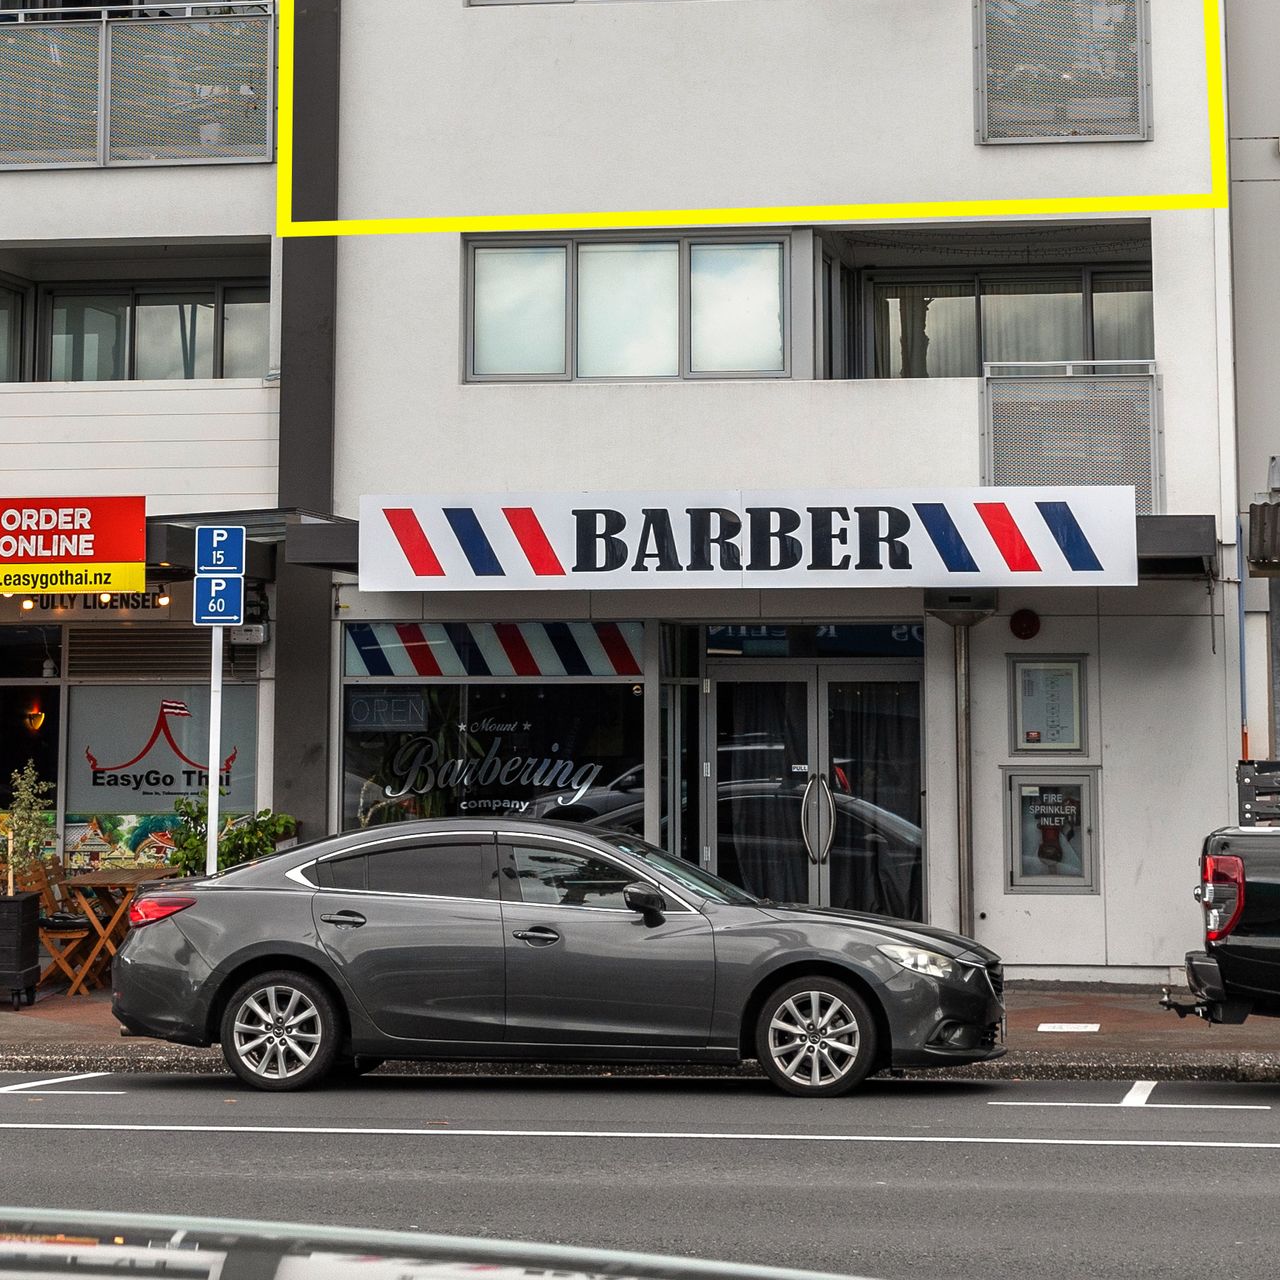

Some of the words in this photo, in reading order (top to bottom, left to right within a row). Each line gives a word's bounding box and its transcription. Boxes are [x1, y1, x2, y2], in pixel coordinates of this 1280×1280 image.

[1, 508, 91, 531] ORDER
[213, 530, 228, 548] P
[572, 506, 912, 572] BARBER
[212, 551, 224, 565] 15
[211, 579, 227, 597] P
[208, 598, 225, 612] 60
[351, 699, 425, 722] OPEN
[470, 717, 518, 733] Mount
[385, 736, 603, 806] Barbering
[92, 770, 175, 790] EasyGo
[460, 798, 529, 812] company
[1043, 794, 1063, 803] FIRE
[1029, 805, 1076, 814] SPRINKLER
[1040, 816, 1065, 826] INLET
